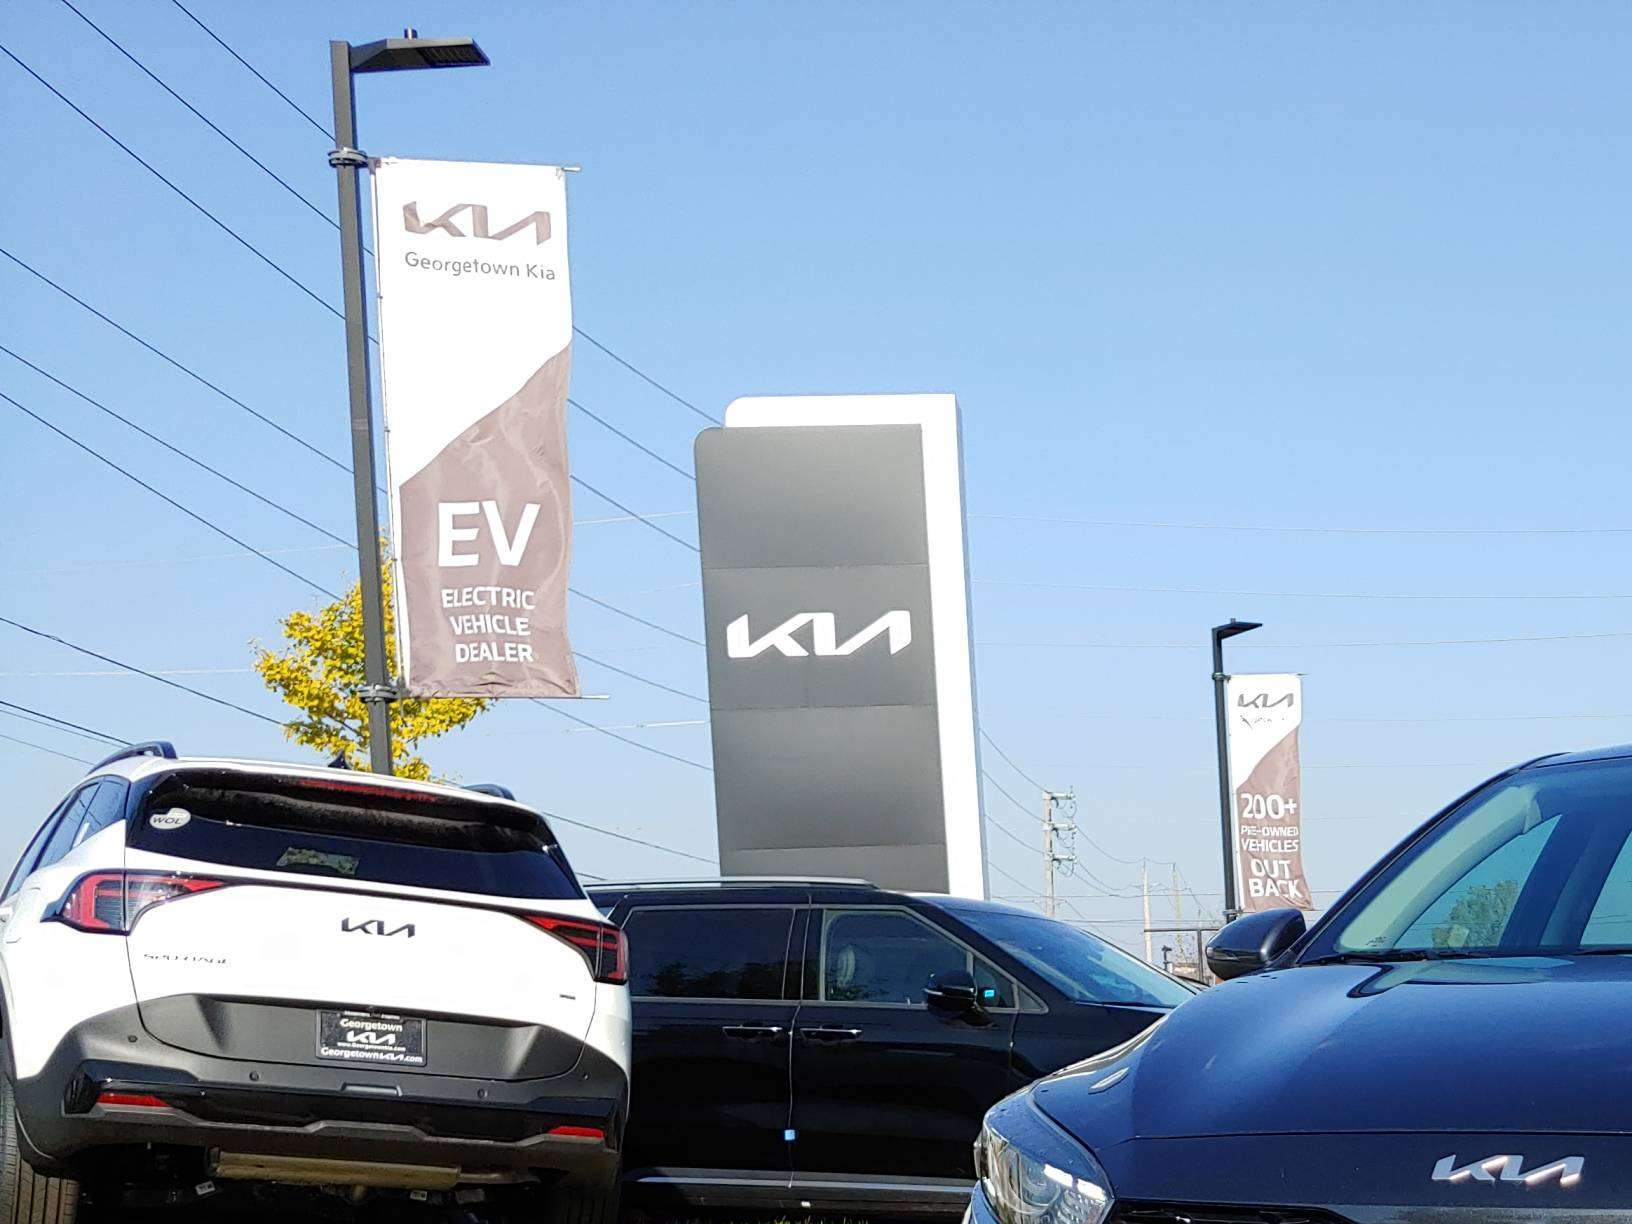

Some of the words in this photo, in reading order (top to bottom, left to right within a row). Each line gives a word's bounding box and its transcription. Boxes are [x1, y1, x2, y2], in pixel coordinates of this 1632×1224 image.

[403, 201, 551, 246] KIA
[405, 251, 520, 277] Georgetown
[526, 263, 556, 280] Kia
[437, 500, 541, 568] EV
[441, 586, 536, 610] ELECTRIC
[449, 614, 531, 637] VEHICLE
[726, 610, 912, 658] KIA
[455, 642, 534, 664] DEALER
[1240, 792, 1298, 820] 200+
[1240, 838, 1299, 853] VEHICLES
[1250, 858, 1292, 879] OUT
[1248, 878, 1304, 899] BACK
[341, 917, 416, 939] KIA
[339, 1018, 404, 1033] Georgetown
[346, 1030, 396, 1046] KIA
[1431, 1154, 1586, 1186] KIA
